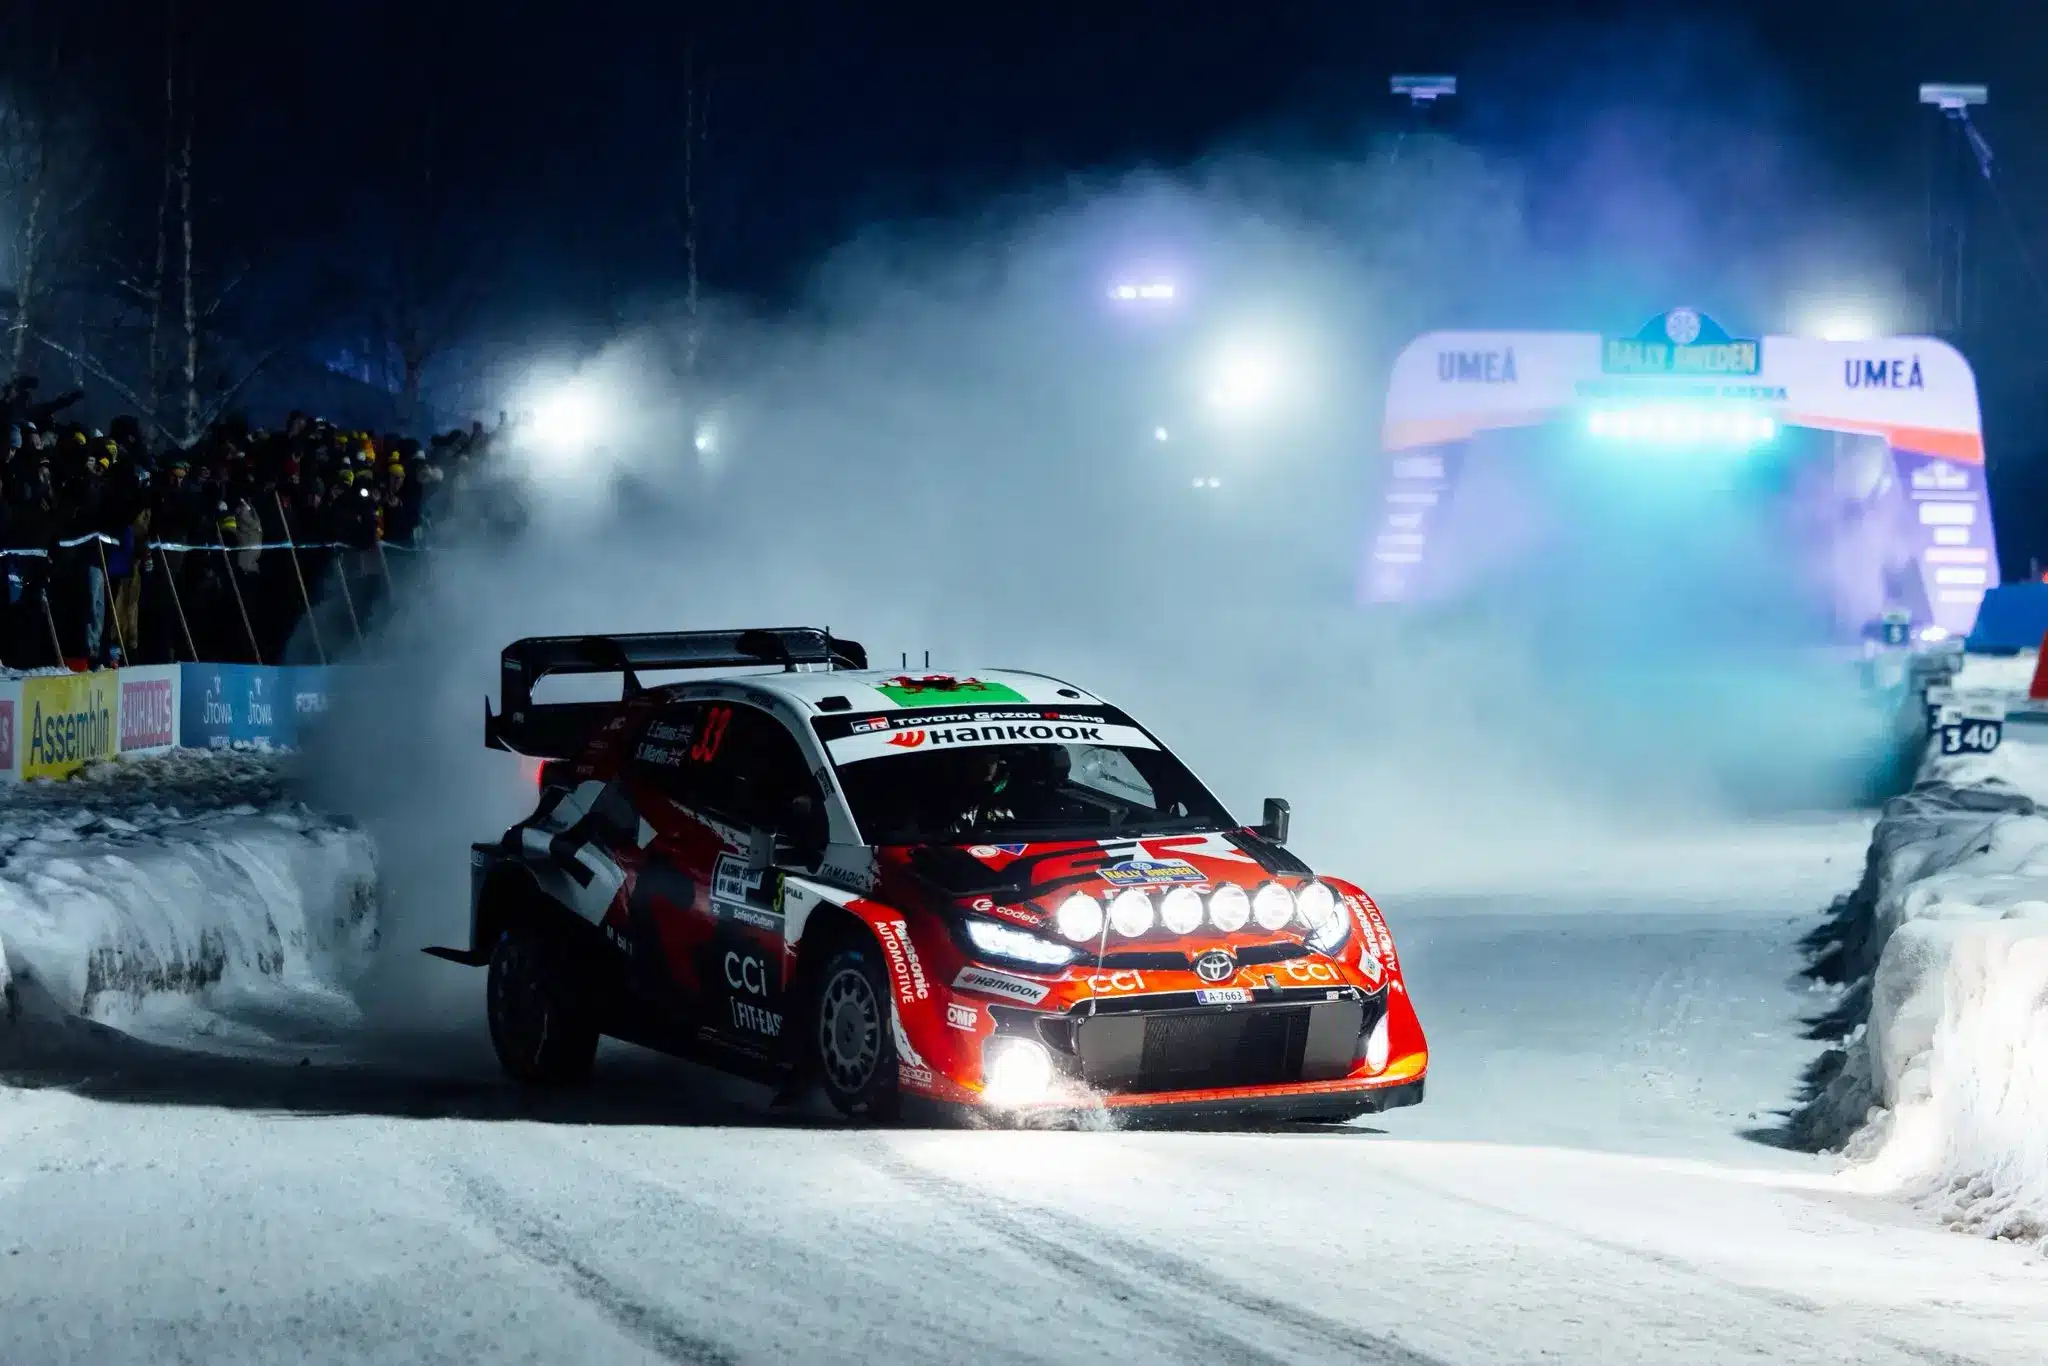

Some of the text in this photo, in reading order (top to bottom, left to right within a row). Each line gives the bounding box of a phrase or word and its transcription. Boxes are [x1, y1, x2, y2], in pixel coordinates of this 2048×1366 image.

[1437, 349, 1518, 384] UMEÅ
[1844, 354, 1925, 389] UMEÅ
[30, 689, 110, 766] Assemblin
[893, 713, 970, 726] TOYOTA
[974, 711, 1041, 722] GAZOO
[1946, 725, 1998, 752] 340
[821, 864, 865, 886] TAMADIC
[1103, 870, 1143, 879] RALLY
[874, 921, 915, 1004] AUTOMOTIVE
[889, 919, 931, 1000] Panasonic
[1209, 991, 1243, 1001] A-7663
[947, 1007, 978, 1027] OMP
